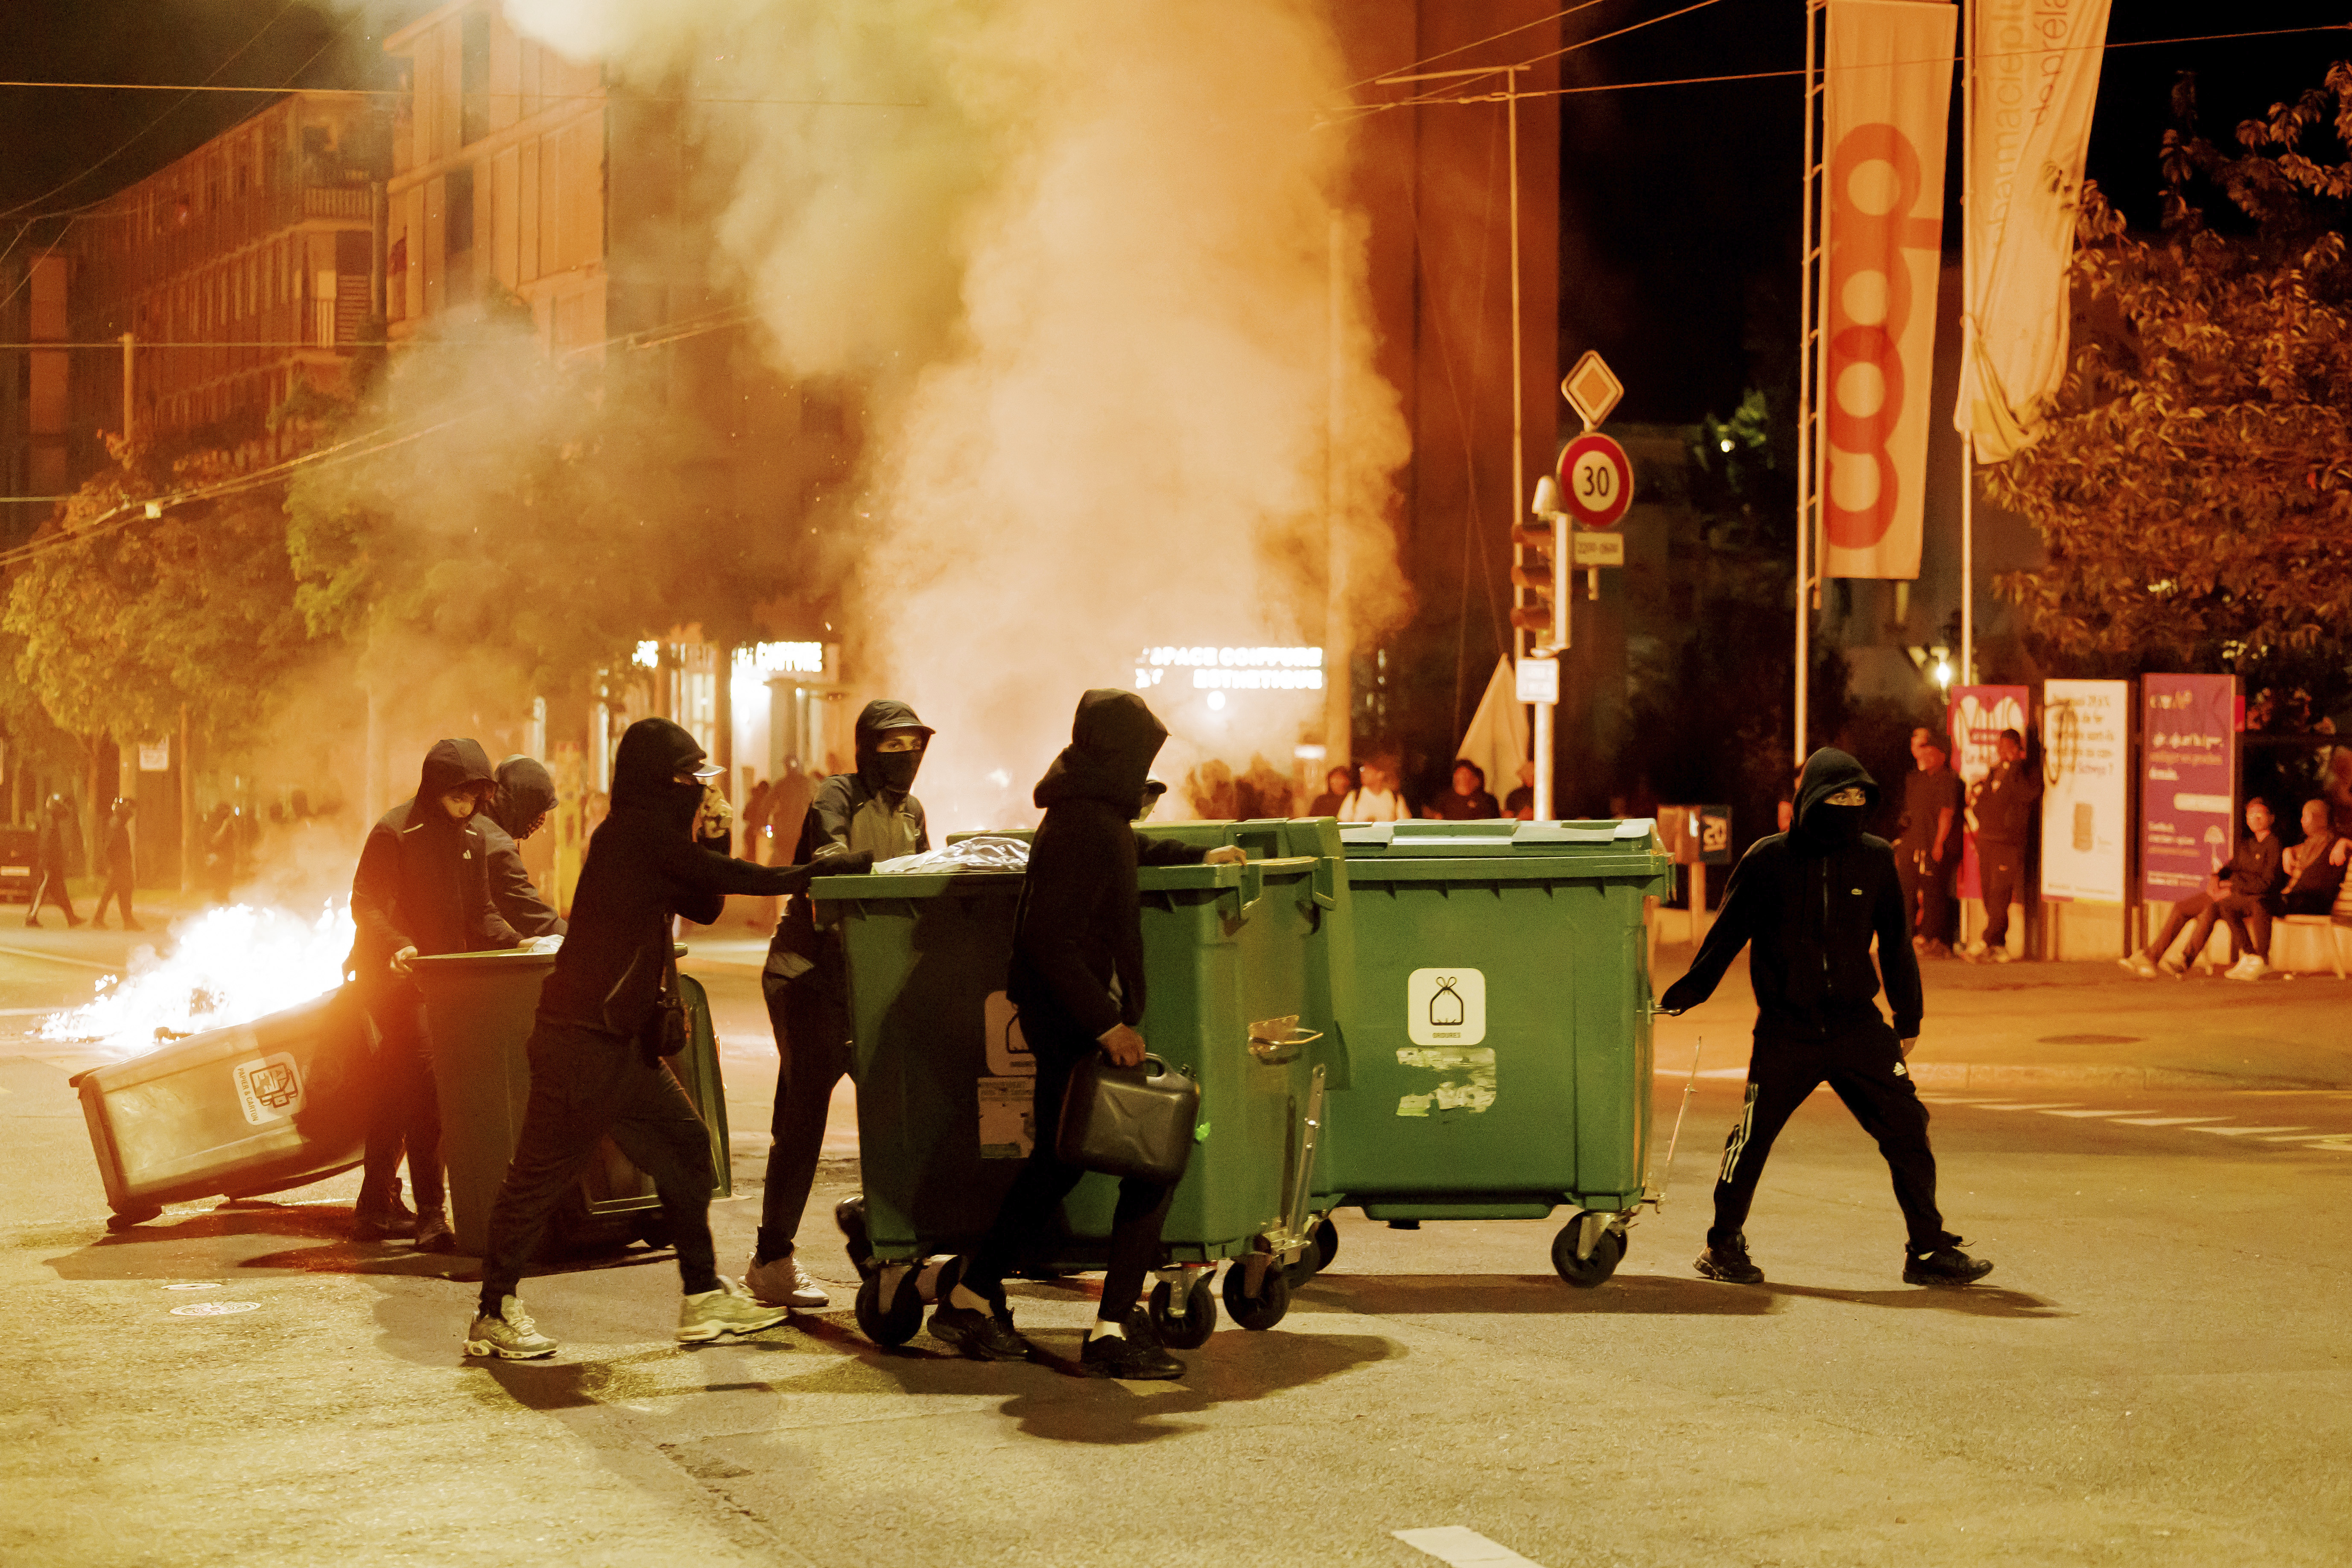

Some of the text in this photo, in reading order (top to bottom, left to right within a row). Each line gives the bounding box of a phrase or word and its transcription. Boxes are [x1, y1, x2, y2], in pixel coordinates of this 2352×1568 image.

[1824, 123, 1942, 549] coop
[1583, 466, 1610, 496] 30
[237, 1068, 249, 1090] PAPIER
[246, 1097, 258, 1121] CARTON
